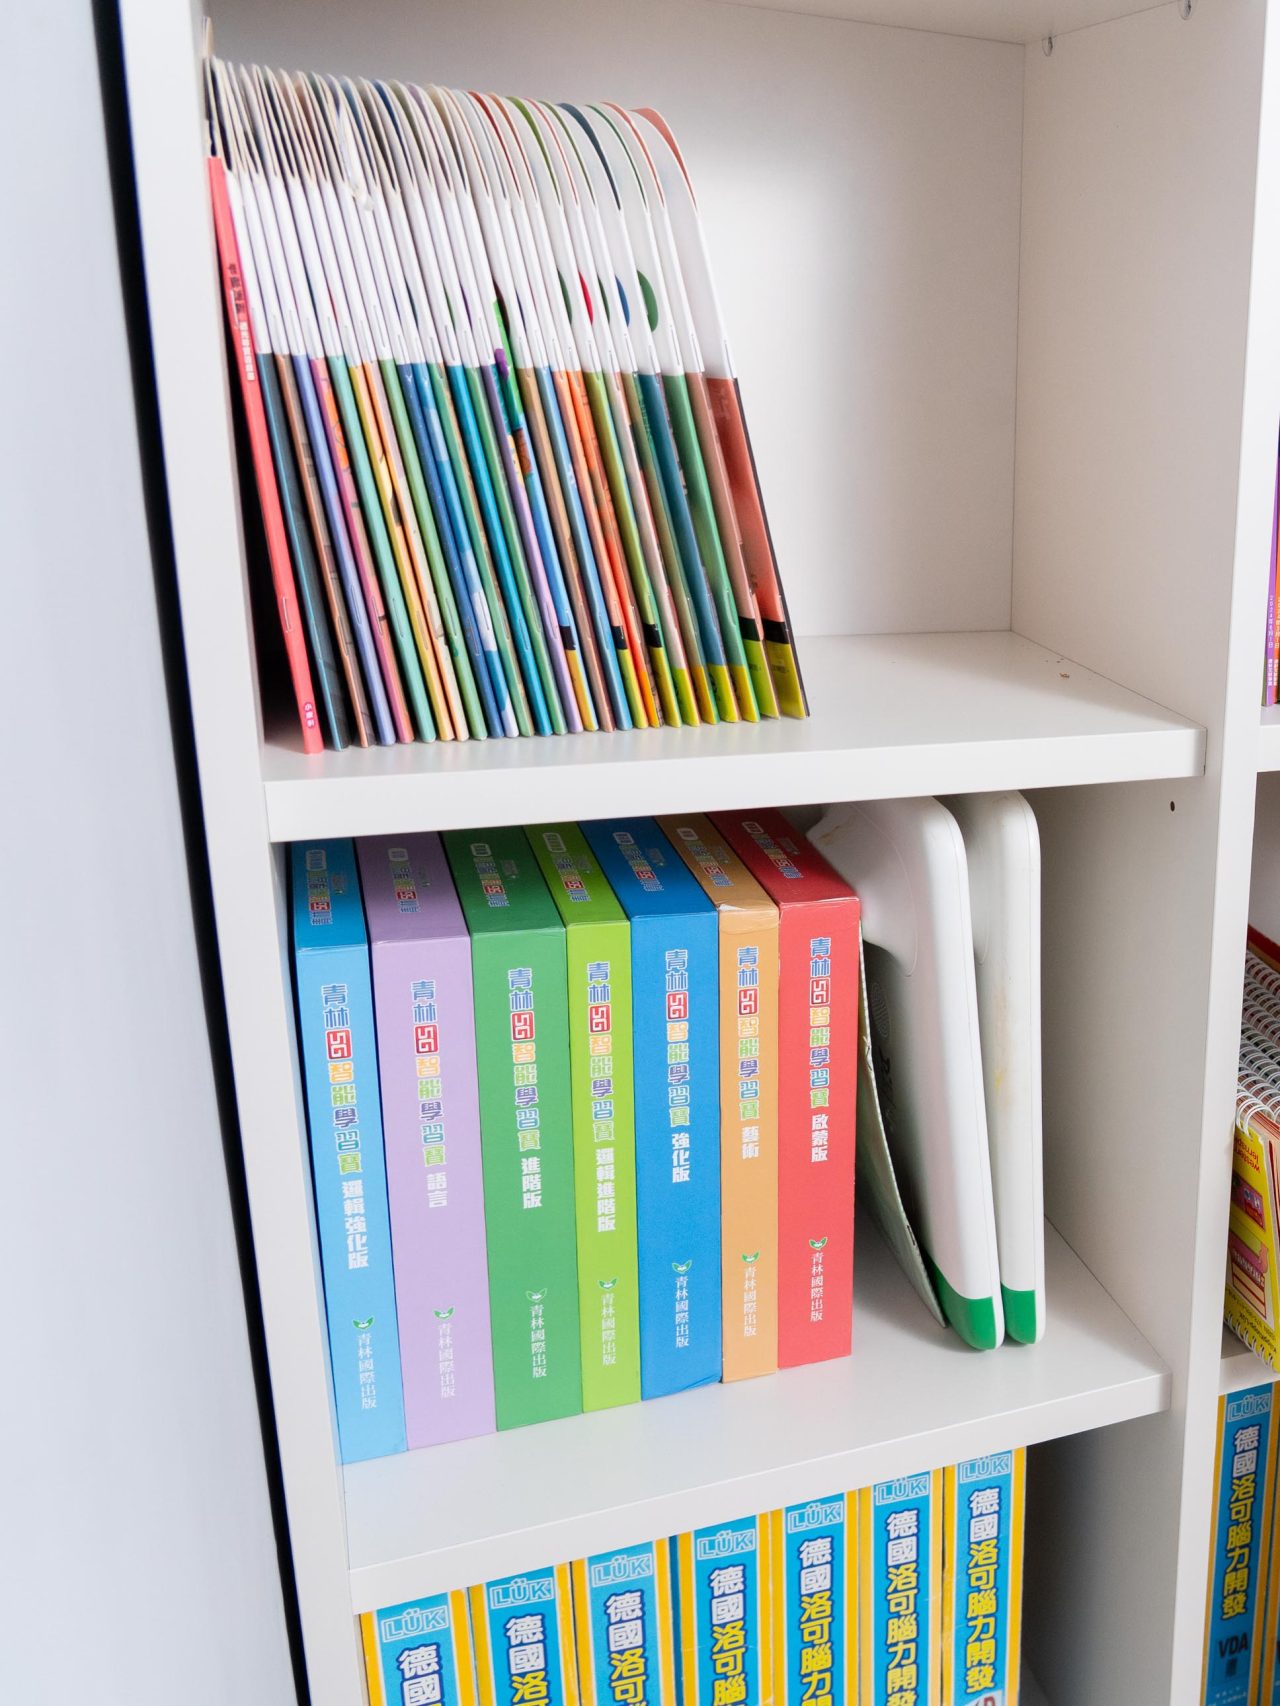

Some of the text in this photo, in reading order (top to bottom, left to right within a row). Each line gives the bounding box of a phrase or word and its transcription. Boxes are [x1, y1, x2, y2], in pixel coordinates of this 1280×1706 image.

[671, 1132, 690, 1184] 強化版
[742, 1125, 759, 1160] 藝術
[425, 1172, 448, 1209] 語言
[521, 1156, 542, 1209] 進階版
[595, 1148, 616, 1233] 邏輯進階版
[341, 1179, 369, 1270] 邏輯強化版
[674, 1275, 689, 1349] 青林國際出版
[742, 1266, 757, 1337] 青林國際出版
[809, 1251, 824, 1323] 青林國際出版
[529, 1303, 547, 1379] 青林國際出版
[600, 1292, 617, 1366] 青林國際出版
[357, 1332, 377, 1410] 青林國際出版
[438, 1322, 456, 1400] 青林國際出版
[1227, 1391, 1272, 1423] LÜK
[876, 1476, 931, 1507] LÜK
[960, 1454, 1012, 1484] LÜK
[697, 1529, 757, 1561] LÜK
[787, 1501, 844, 1534] LÜK
[1220, 1424, 1260, 1621] 德國洛可腦力開發
[491, 1578, 555, 1609] LÜK
[591, 1554, 654, 1588] LÜK
[965, 1487, 1000, 1694] 德國洛可腦力開發
[381, 1606, 450, 1643] LÜK
[606, 1590, 649, 1706] 德國洛可
[1218, 1631, 1249, 1660] VDA
[399, 1644, 443, 1706] 德國
[505, 1614, 550, 1706] 德國洛
